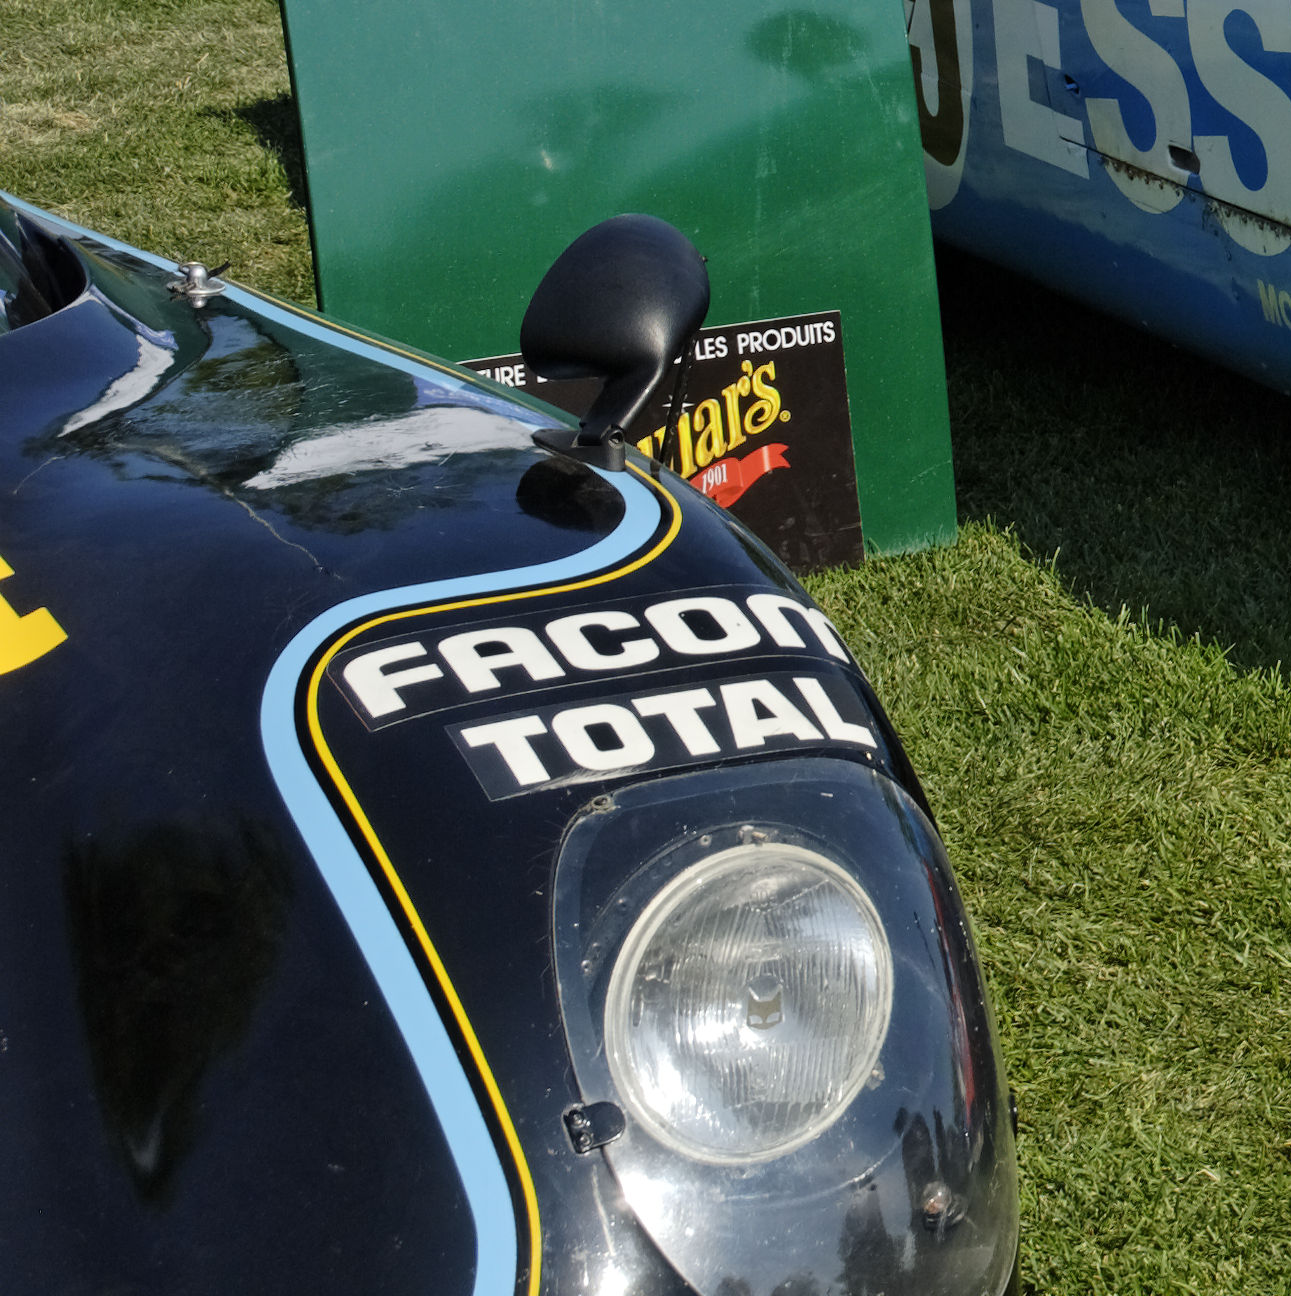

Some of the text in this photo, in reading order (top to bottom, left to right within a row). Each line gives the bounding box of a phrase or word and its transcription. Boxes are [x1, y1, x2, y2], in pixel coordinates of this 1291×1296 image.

[694, 320, 837, 361] LES PRODUITS
[701, 463, 729, 495] 1901
[342, 593, 853, 720] FACOM
[461, 675, 878, 788] TOTAL
